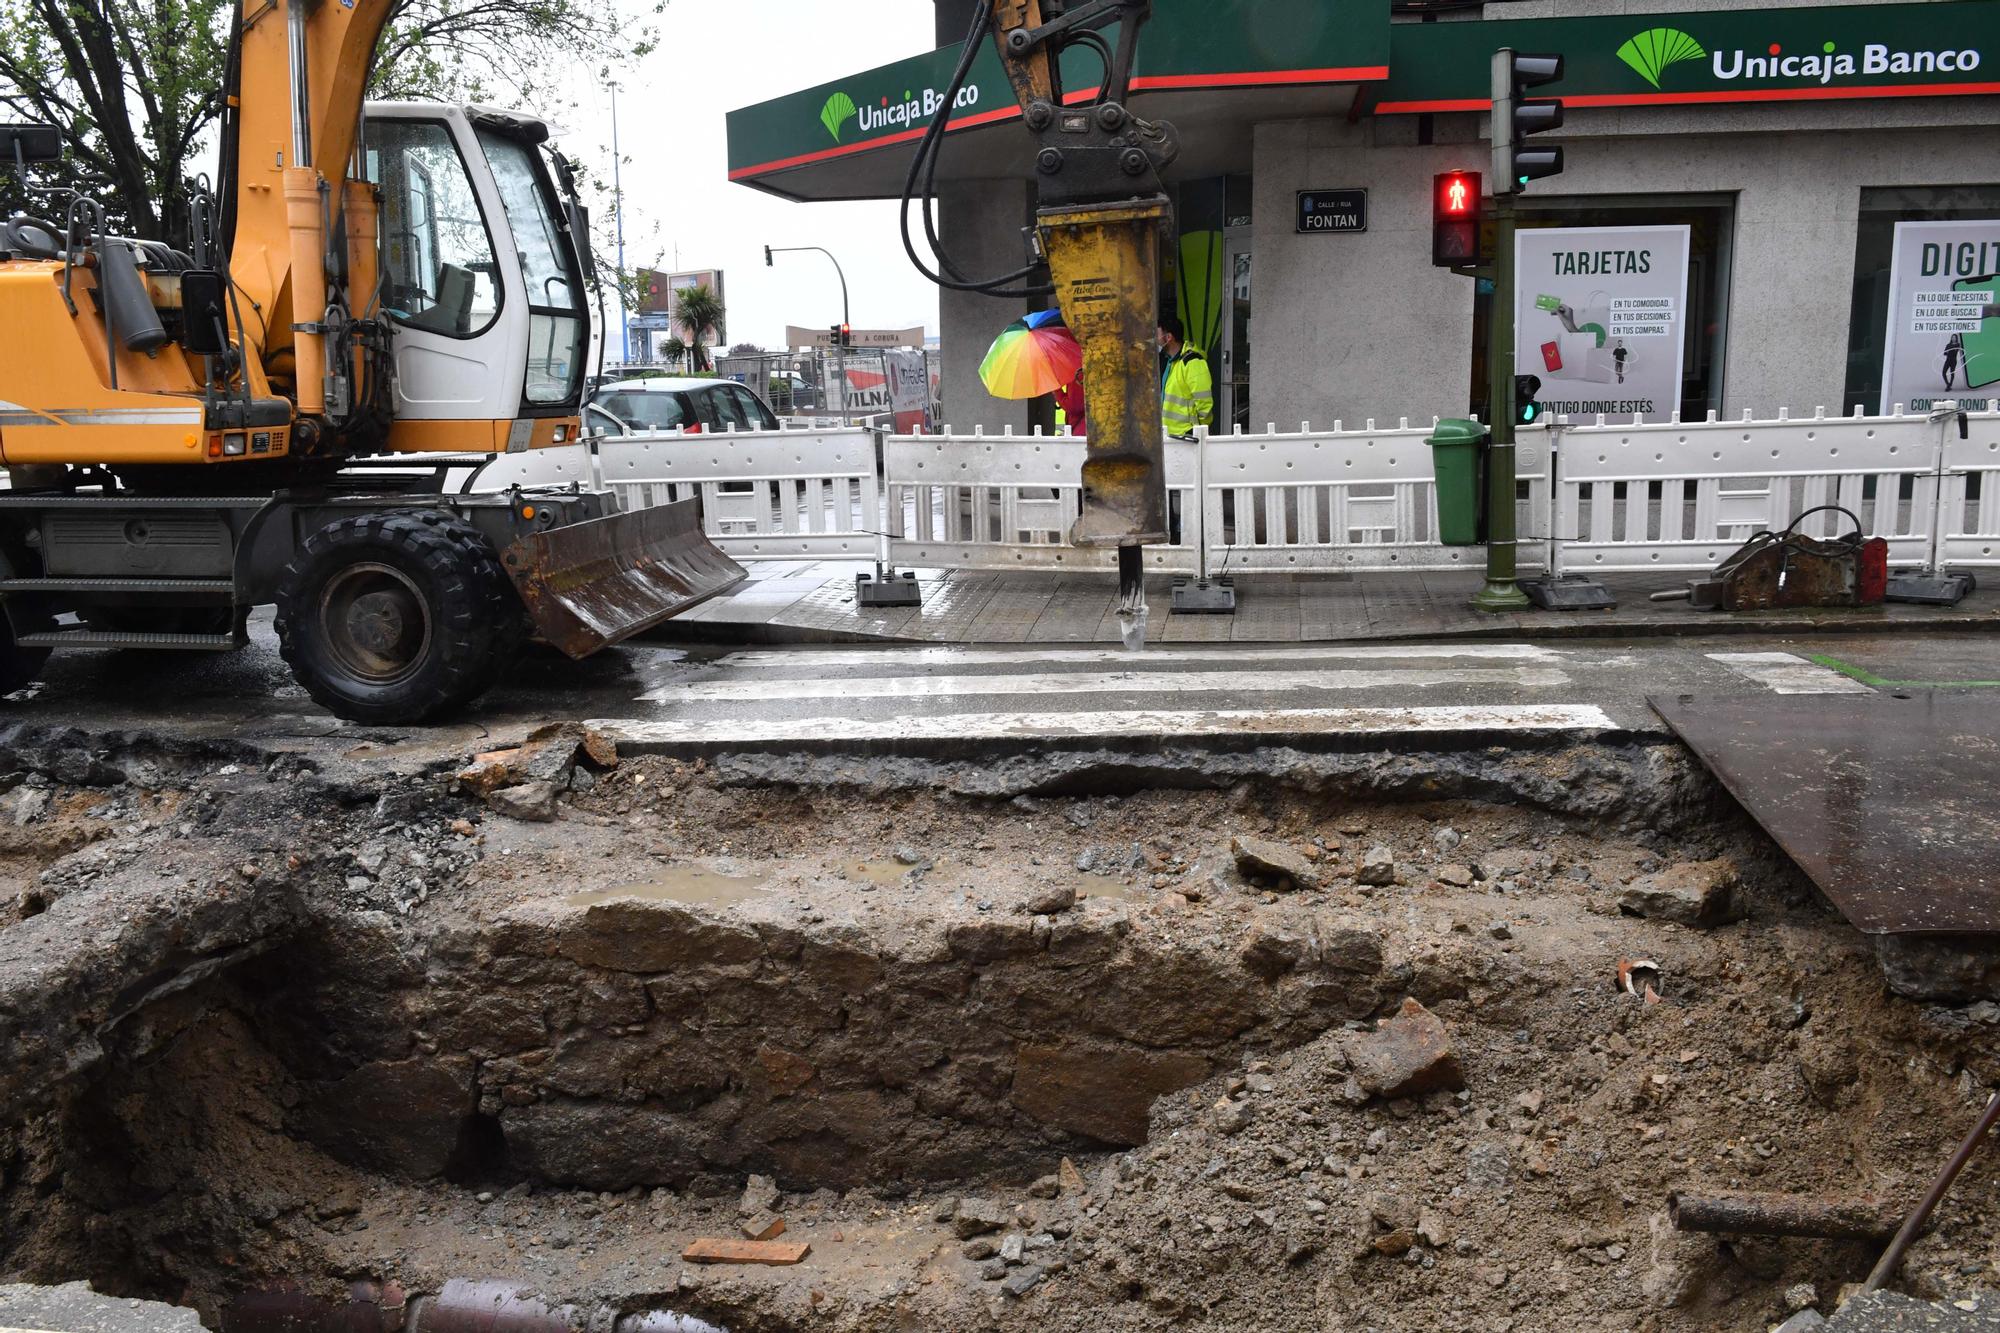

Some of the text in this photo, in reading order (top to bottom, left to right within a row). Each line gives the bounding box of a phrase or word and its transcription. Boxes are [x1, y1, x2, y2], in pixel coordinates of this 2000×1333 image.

[1713, 41, 1980, 85] Unicaja Banco
[859, 90, 921, 131] Unicaja
[1306, 214, 1357, 228] FONTAN
[1552, 250, 1651, 275] TARJETAS
[1937, 294, 1950, 302] QUE
[1636, 312, 1672, 320] DECISIONES.
[1916, 308, 1924, 316] EN
[1926, 308, 1934, 316] LO
[1936, 308, 1948, 316] QUE
[1914, 323, 1924, 331] EN
[1926, 322, 1938, 330] TUS
[1541, 398, 1656, 414] ONTIGO DONDE ESTÉS.
